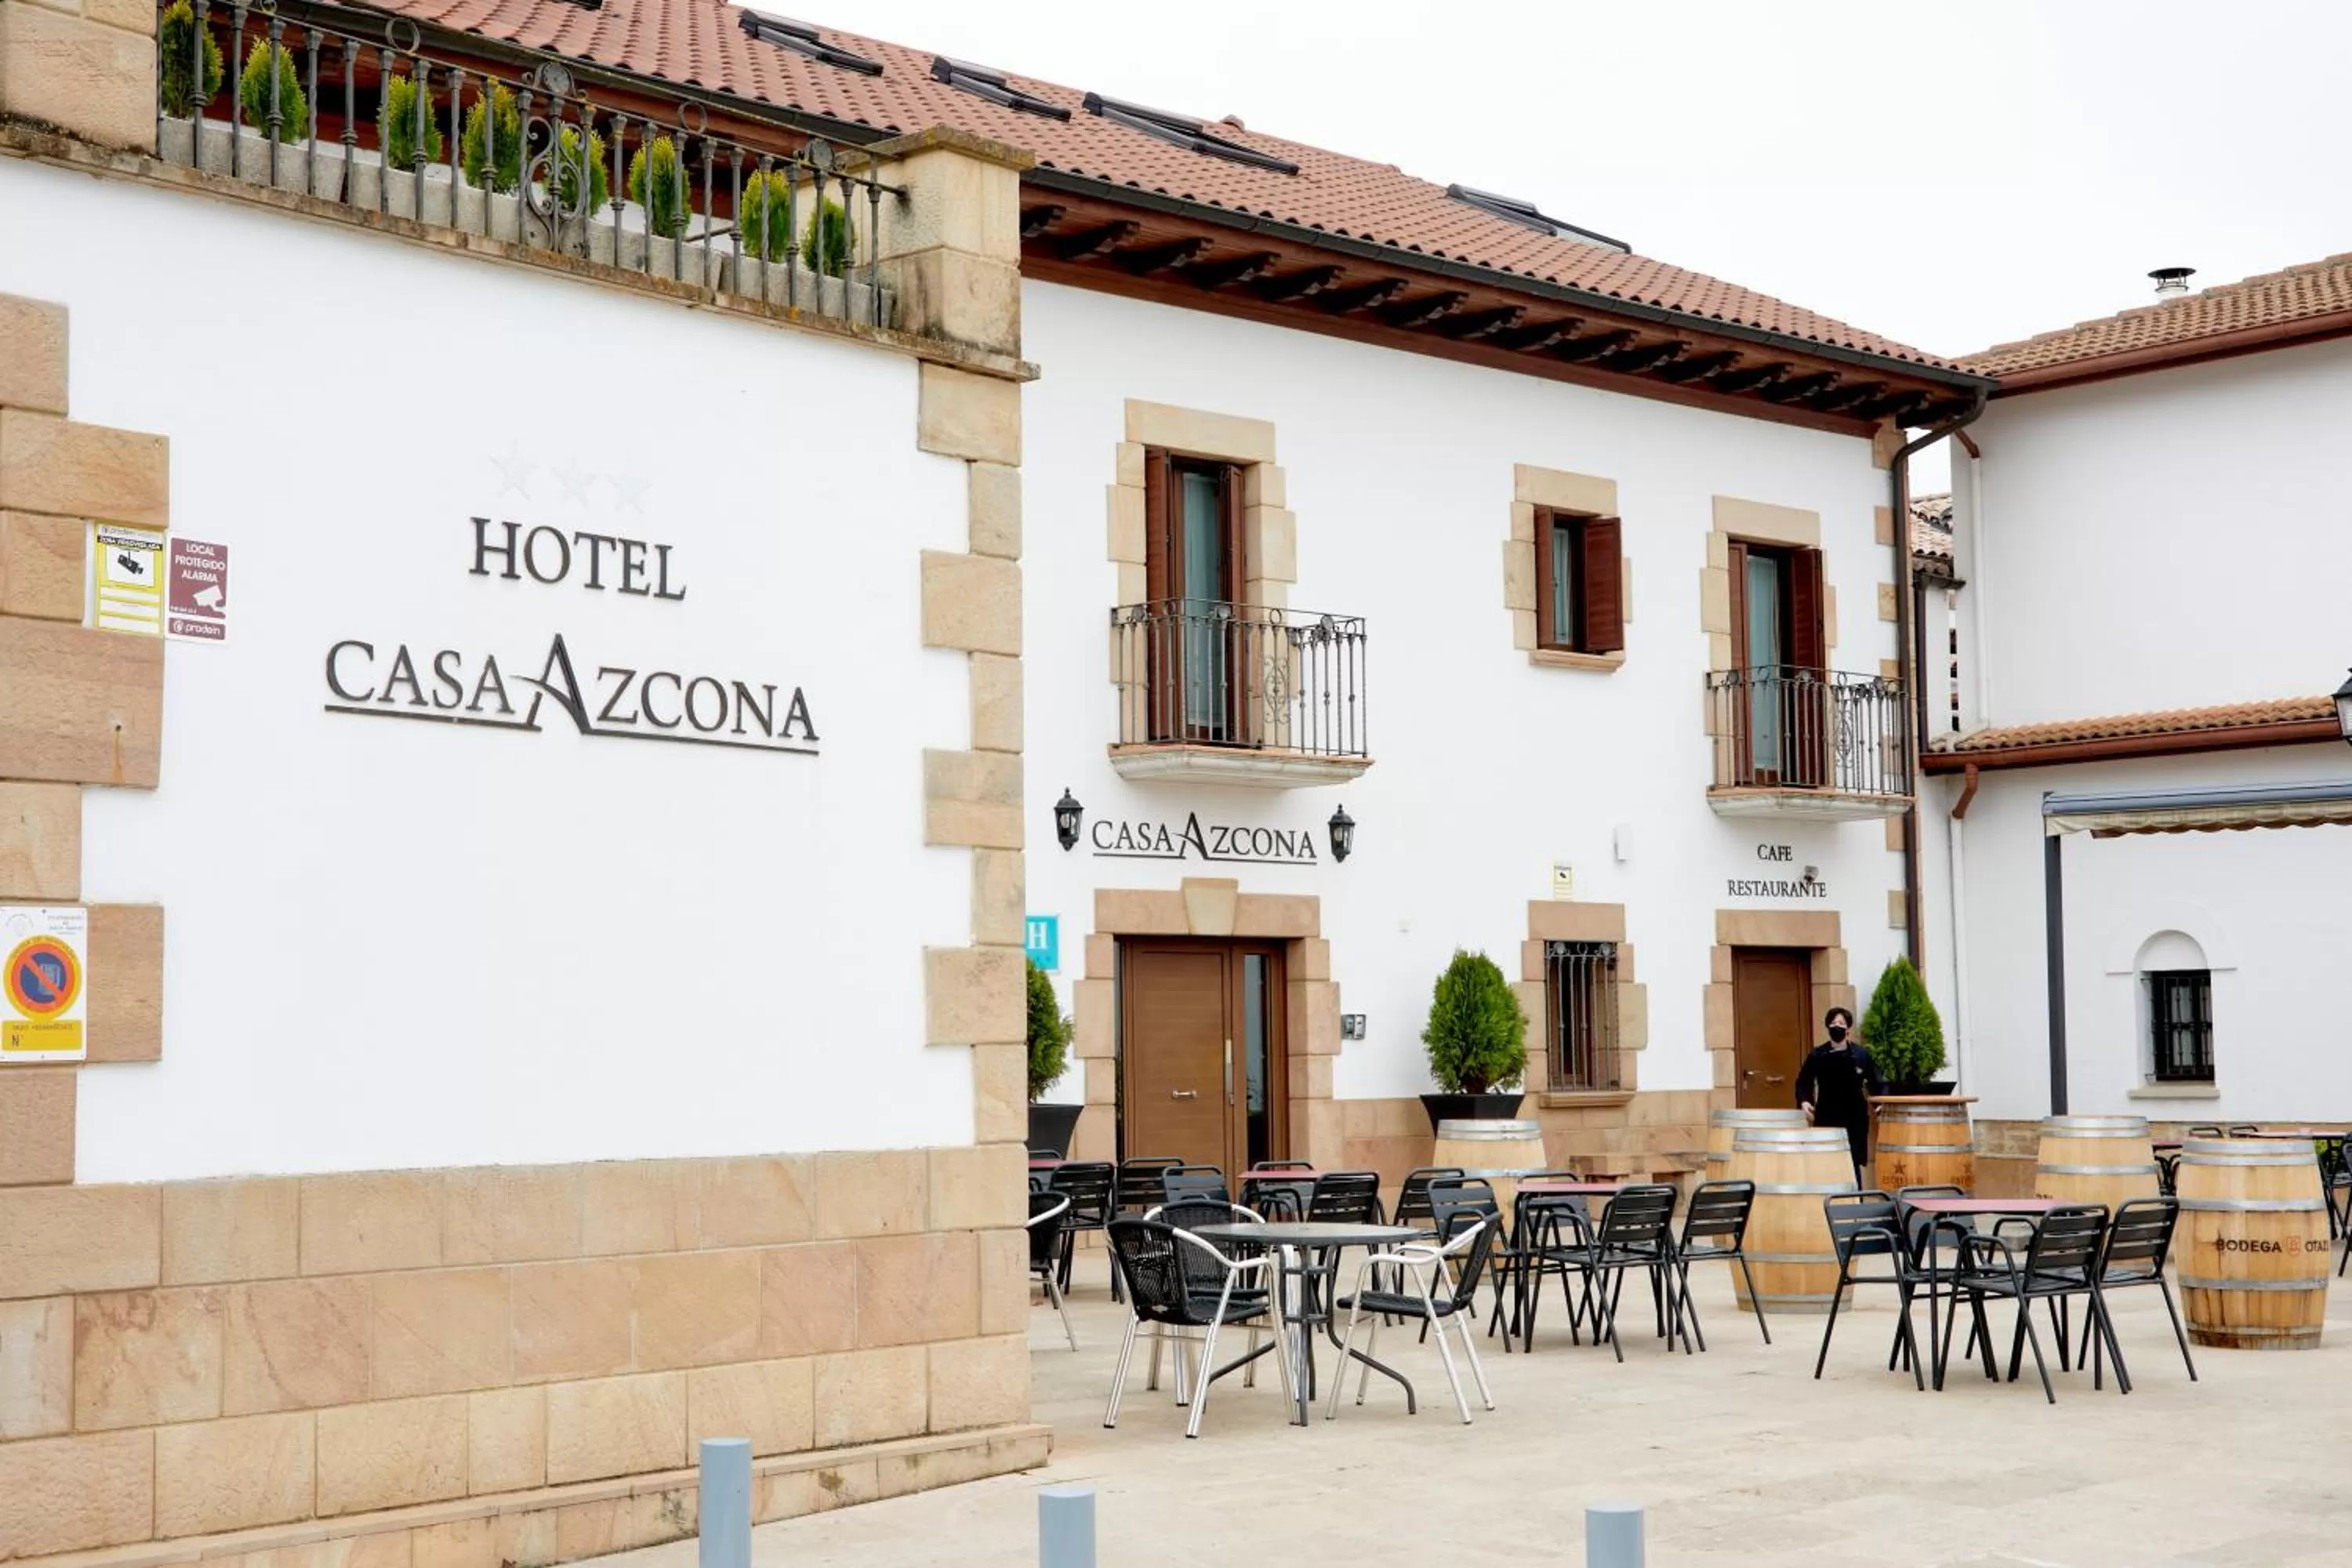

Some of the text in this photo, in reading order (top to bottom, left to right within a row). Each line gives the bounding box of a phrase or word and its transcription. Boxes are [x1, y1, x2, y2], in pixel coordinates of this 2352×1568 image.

[186, 543, 215, 556] LOCAL
[469, 517, 687, 601] HOTEL
[175, 554, 226, 572] PROTEGIDO
[181, 568, 218, 583] ALARMA
[325, 633, 820, 741] CASA AZCONA
[1092, 811, 1317, 859] CASA AZCONA
[1757, 844, 1793, 862] CAFE
[1727, 878, 1827, 898] RESTAURANTE
[1028, 921, 1047, 950] H
[2216, 1238, 2283, 1254] BODEGA
